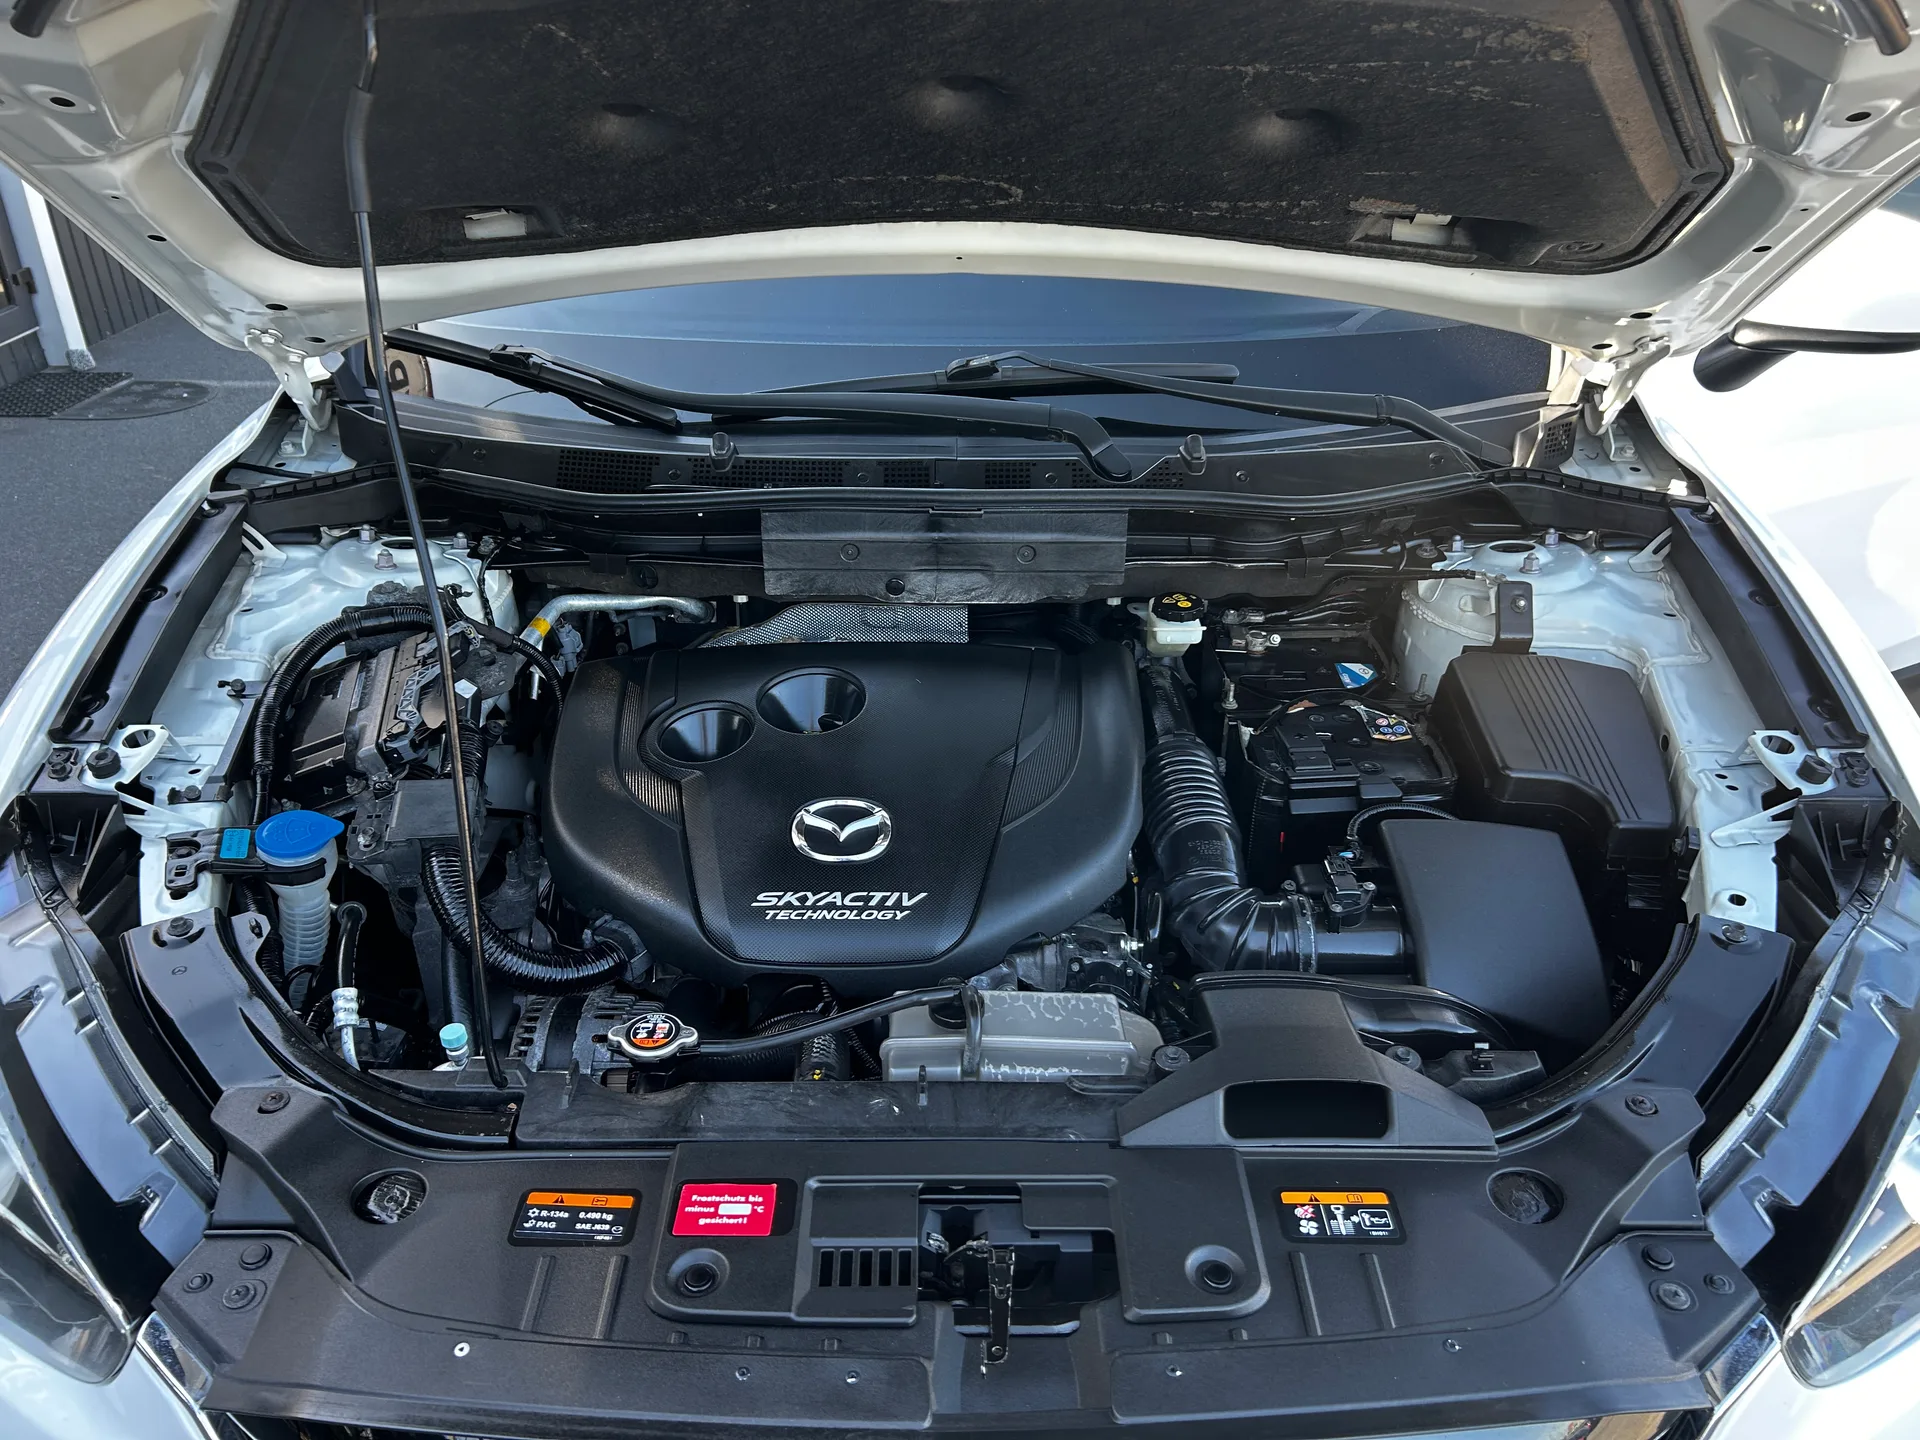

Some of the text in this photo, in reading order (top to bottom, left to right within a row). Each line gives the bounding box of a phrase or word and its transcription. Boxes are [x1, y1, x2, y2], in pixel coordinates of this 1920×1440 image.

[750, 891, 928, 907] SKYACTIV
[765, 910, 911, 920] TECHNOLOGY
[602, 1213, 613, 1221] kg
[698, 1217, 747, 1225] gesichert!
[536, 1221, 556, 1229] PAG
